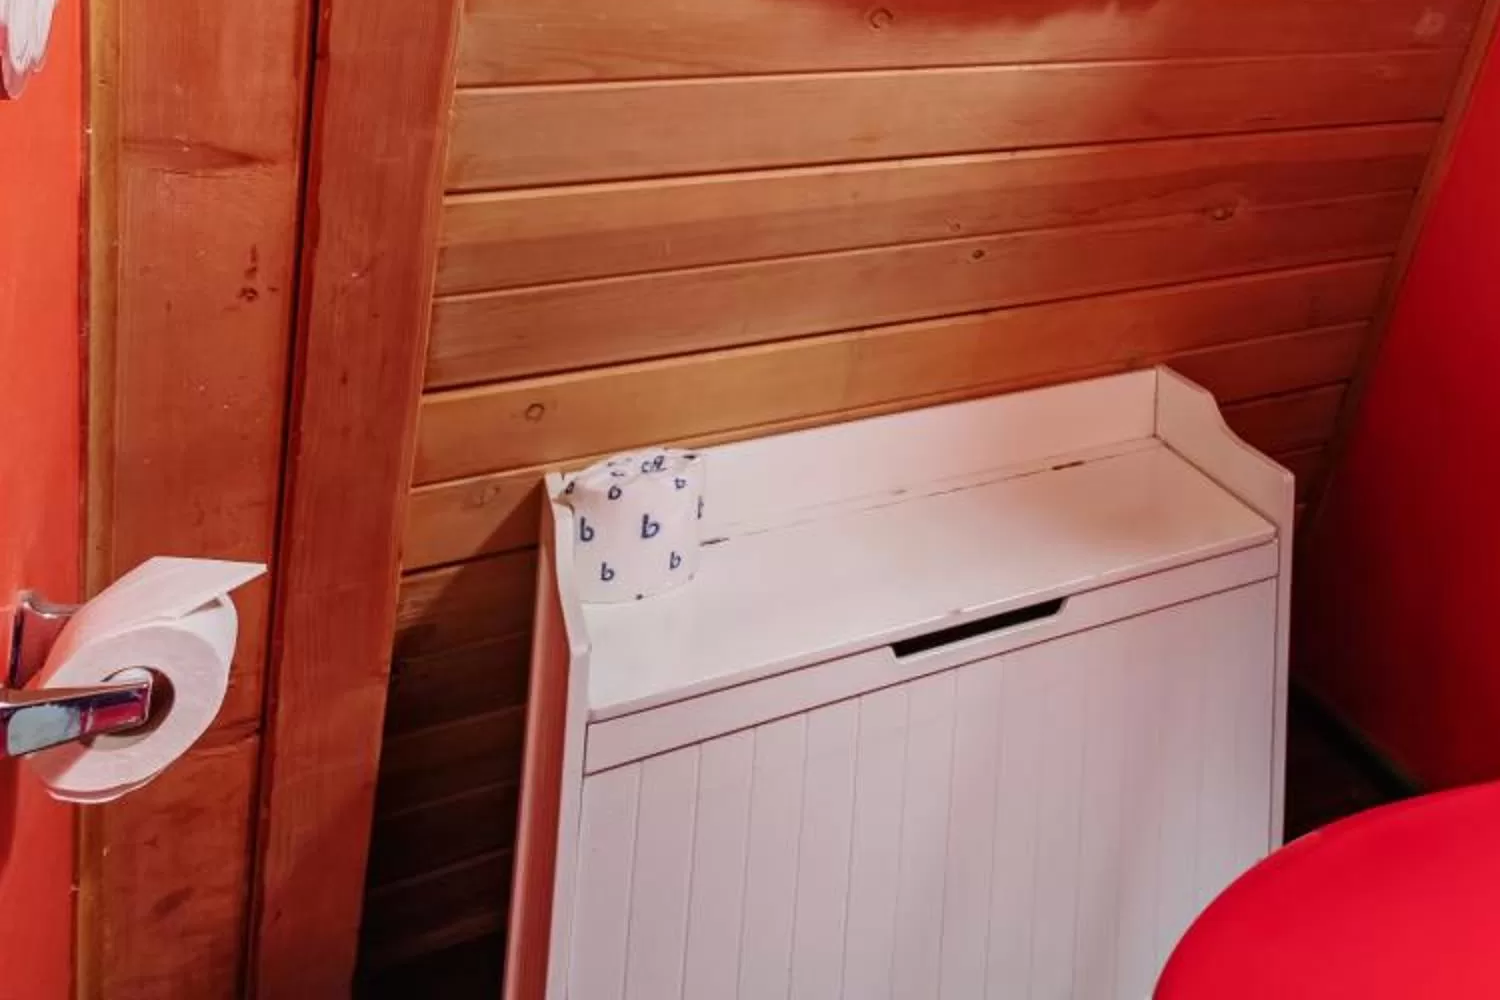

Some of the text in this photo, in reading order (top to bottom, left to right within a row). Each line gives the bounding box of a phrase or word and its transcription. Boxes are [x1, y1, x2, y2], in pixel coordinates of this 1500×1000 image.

[580, 516, 594, 542] b
[641, 513, 660, 539] b
[600, 561, 615, 581] b
[669, 551, 682, 570] b
